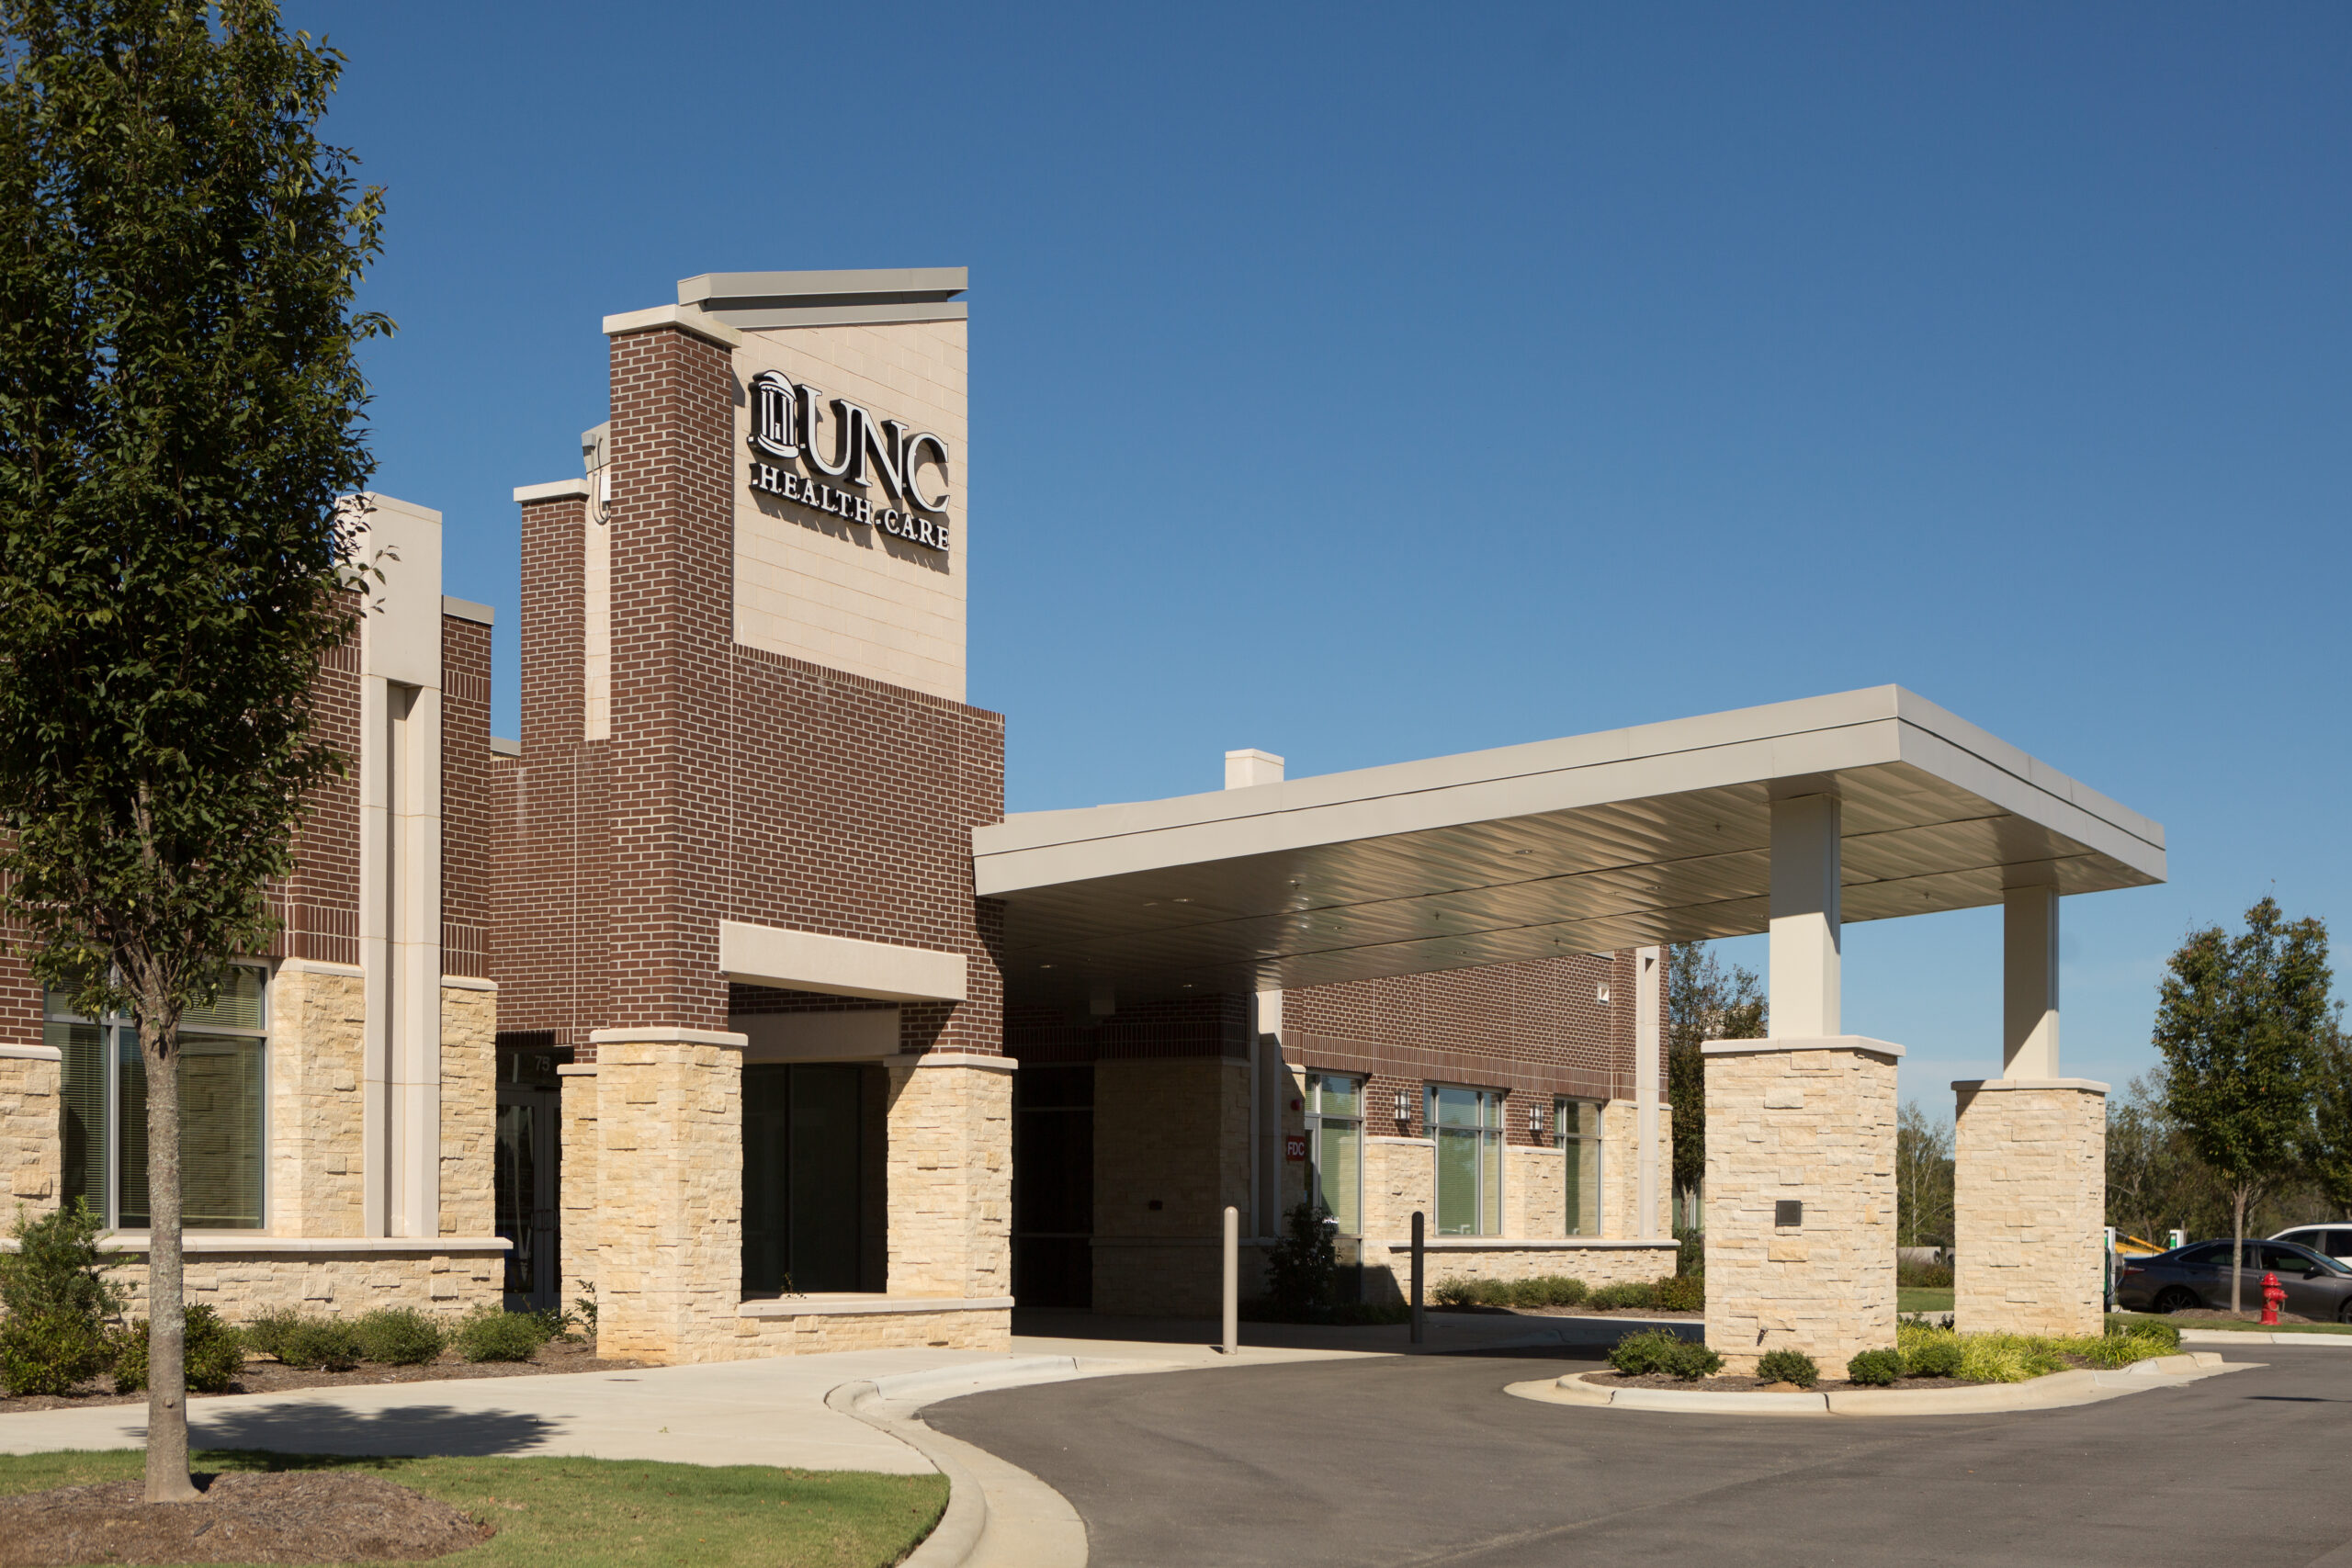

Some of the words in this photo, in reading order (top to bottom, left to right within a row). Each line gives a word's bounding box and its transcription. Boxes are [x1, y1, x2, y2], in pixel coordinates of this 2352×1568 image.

[797, 384, 950, 513] UNC
[756, 463, 873, 525] HEALTH
[882, 509, 950, 551] CARE
[535, 1055, 550, 1072] 75
[1287, 1141, 1305, 1156] FDC
